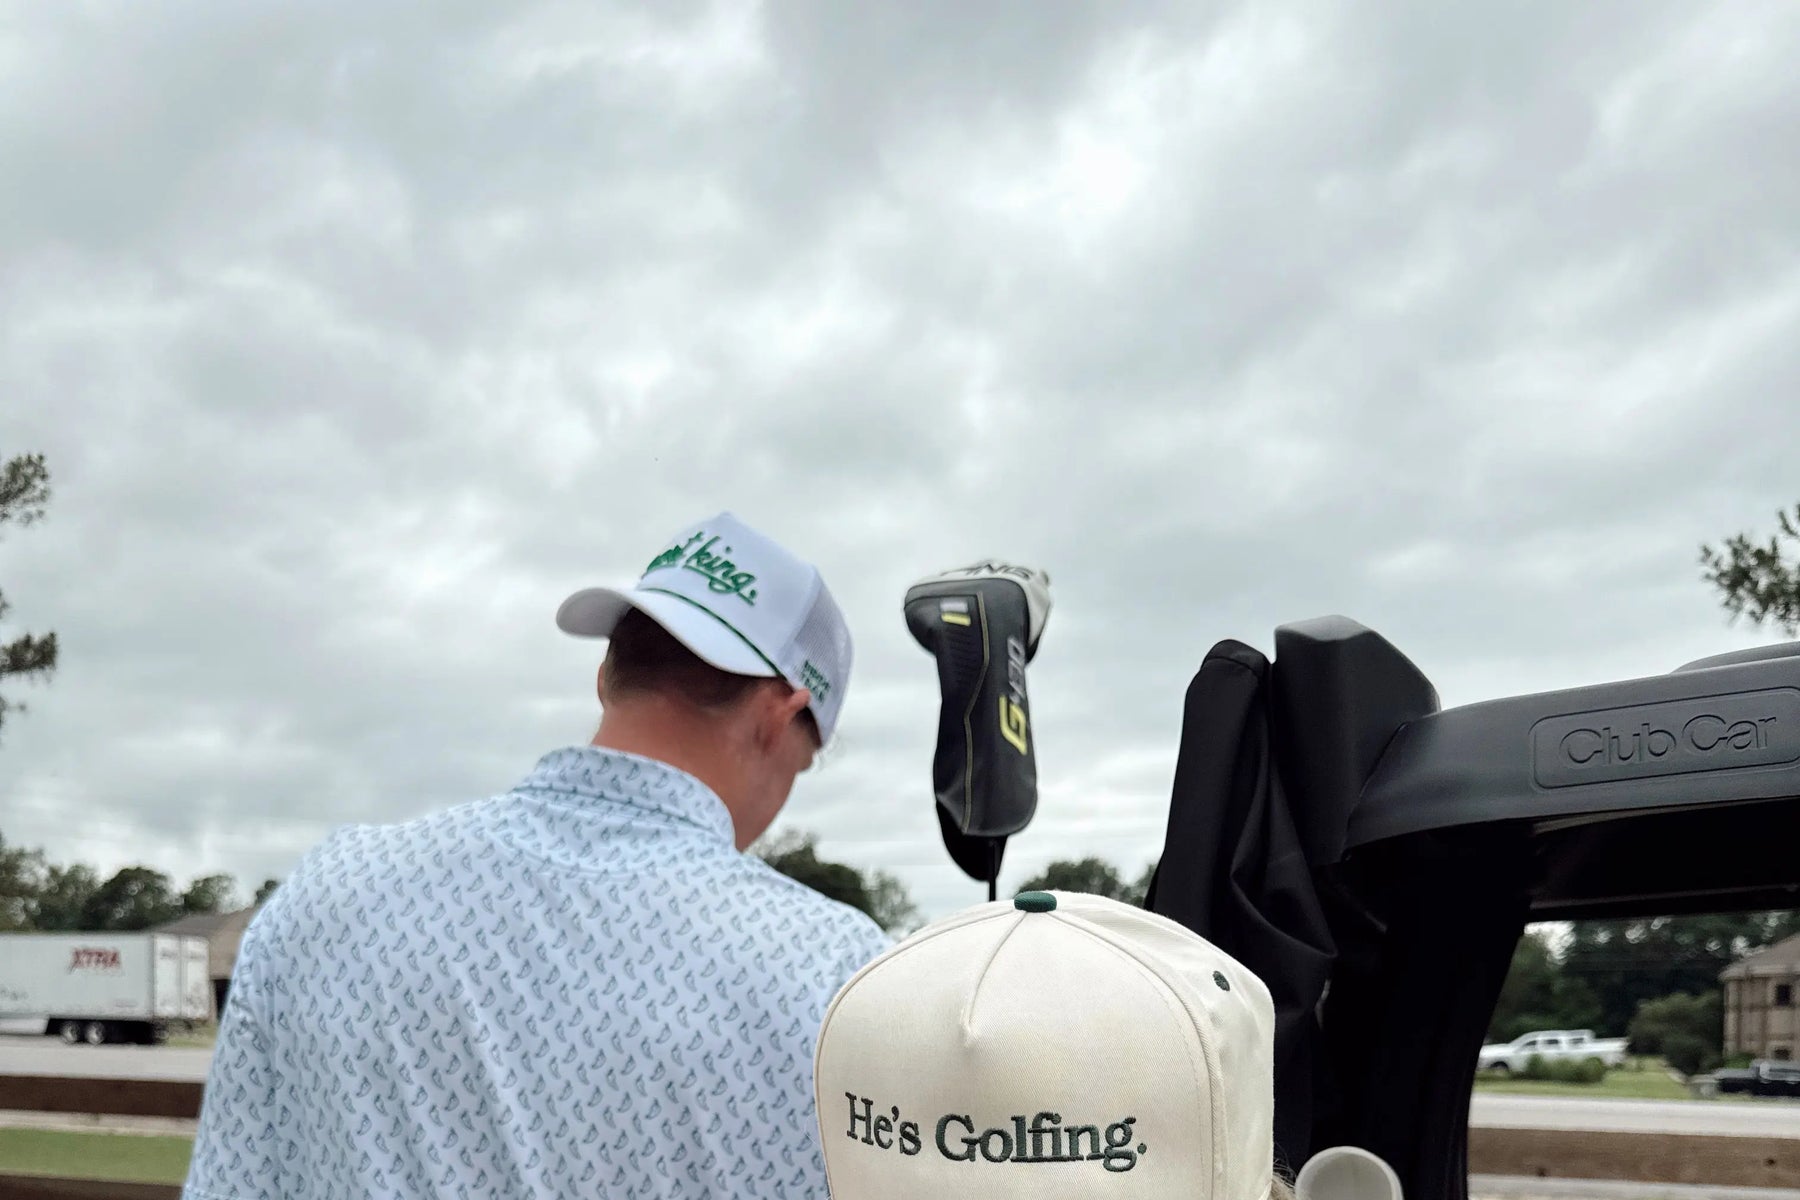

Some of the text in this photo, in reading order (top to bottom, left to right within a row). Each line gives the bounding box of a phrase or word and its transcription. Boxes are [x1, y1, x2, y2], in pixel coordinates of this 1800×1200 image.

[1559, 714, 1777, 768] Club Car
[845, 1091, 1147, 1172] He's Golfing.
